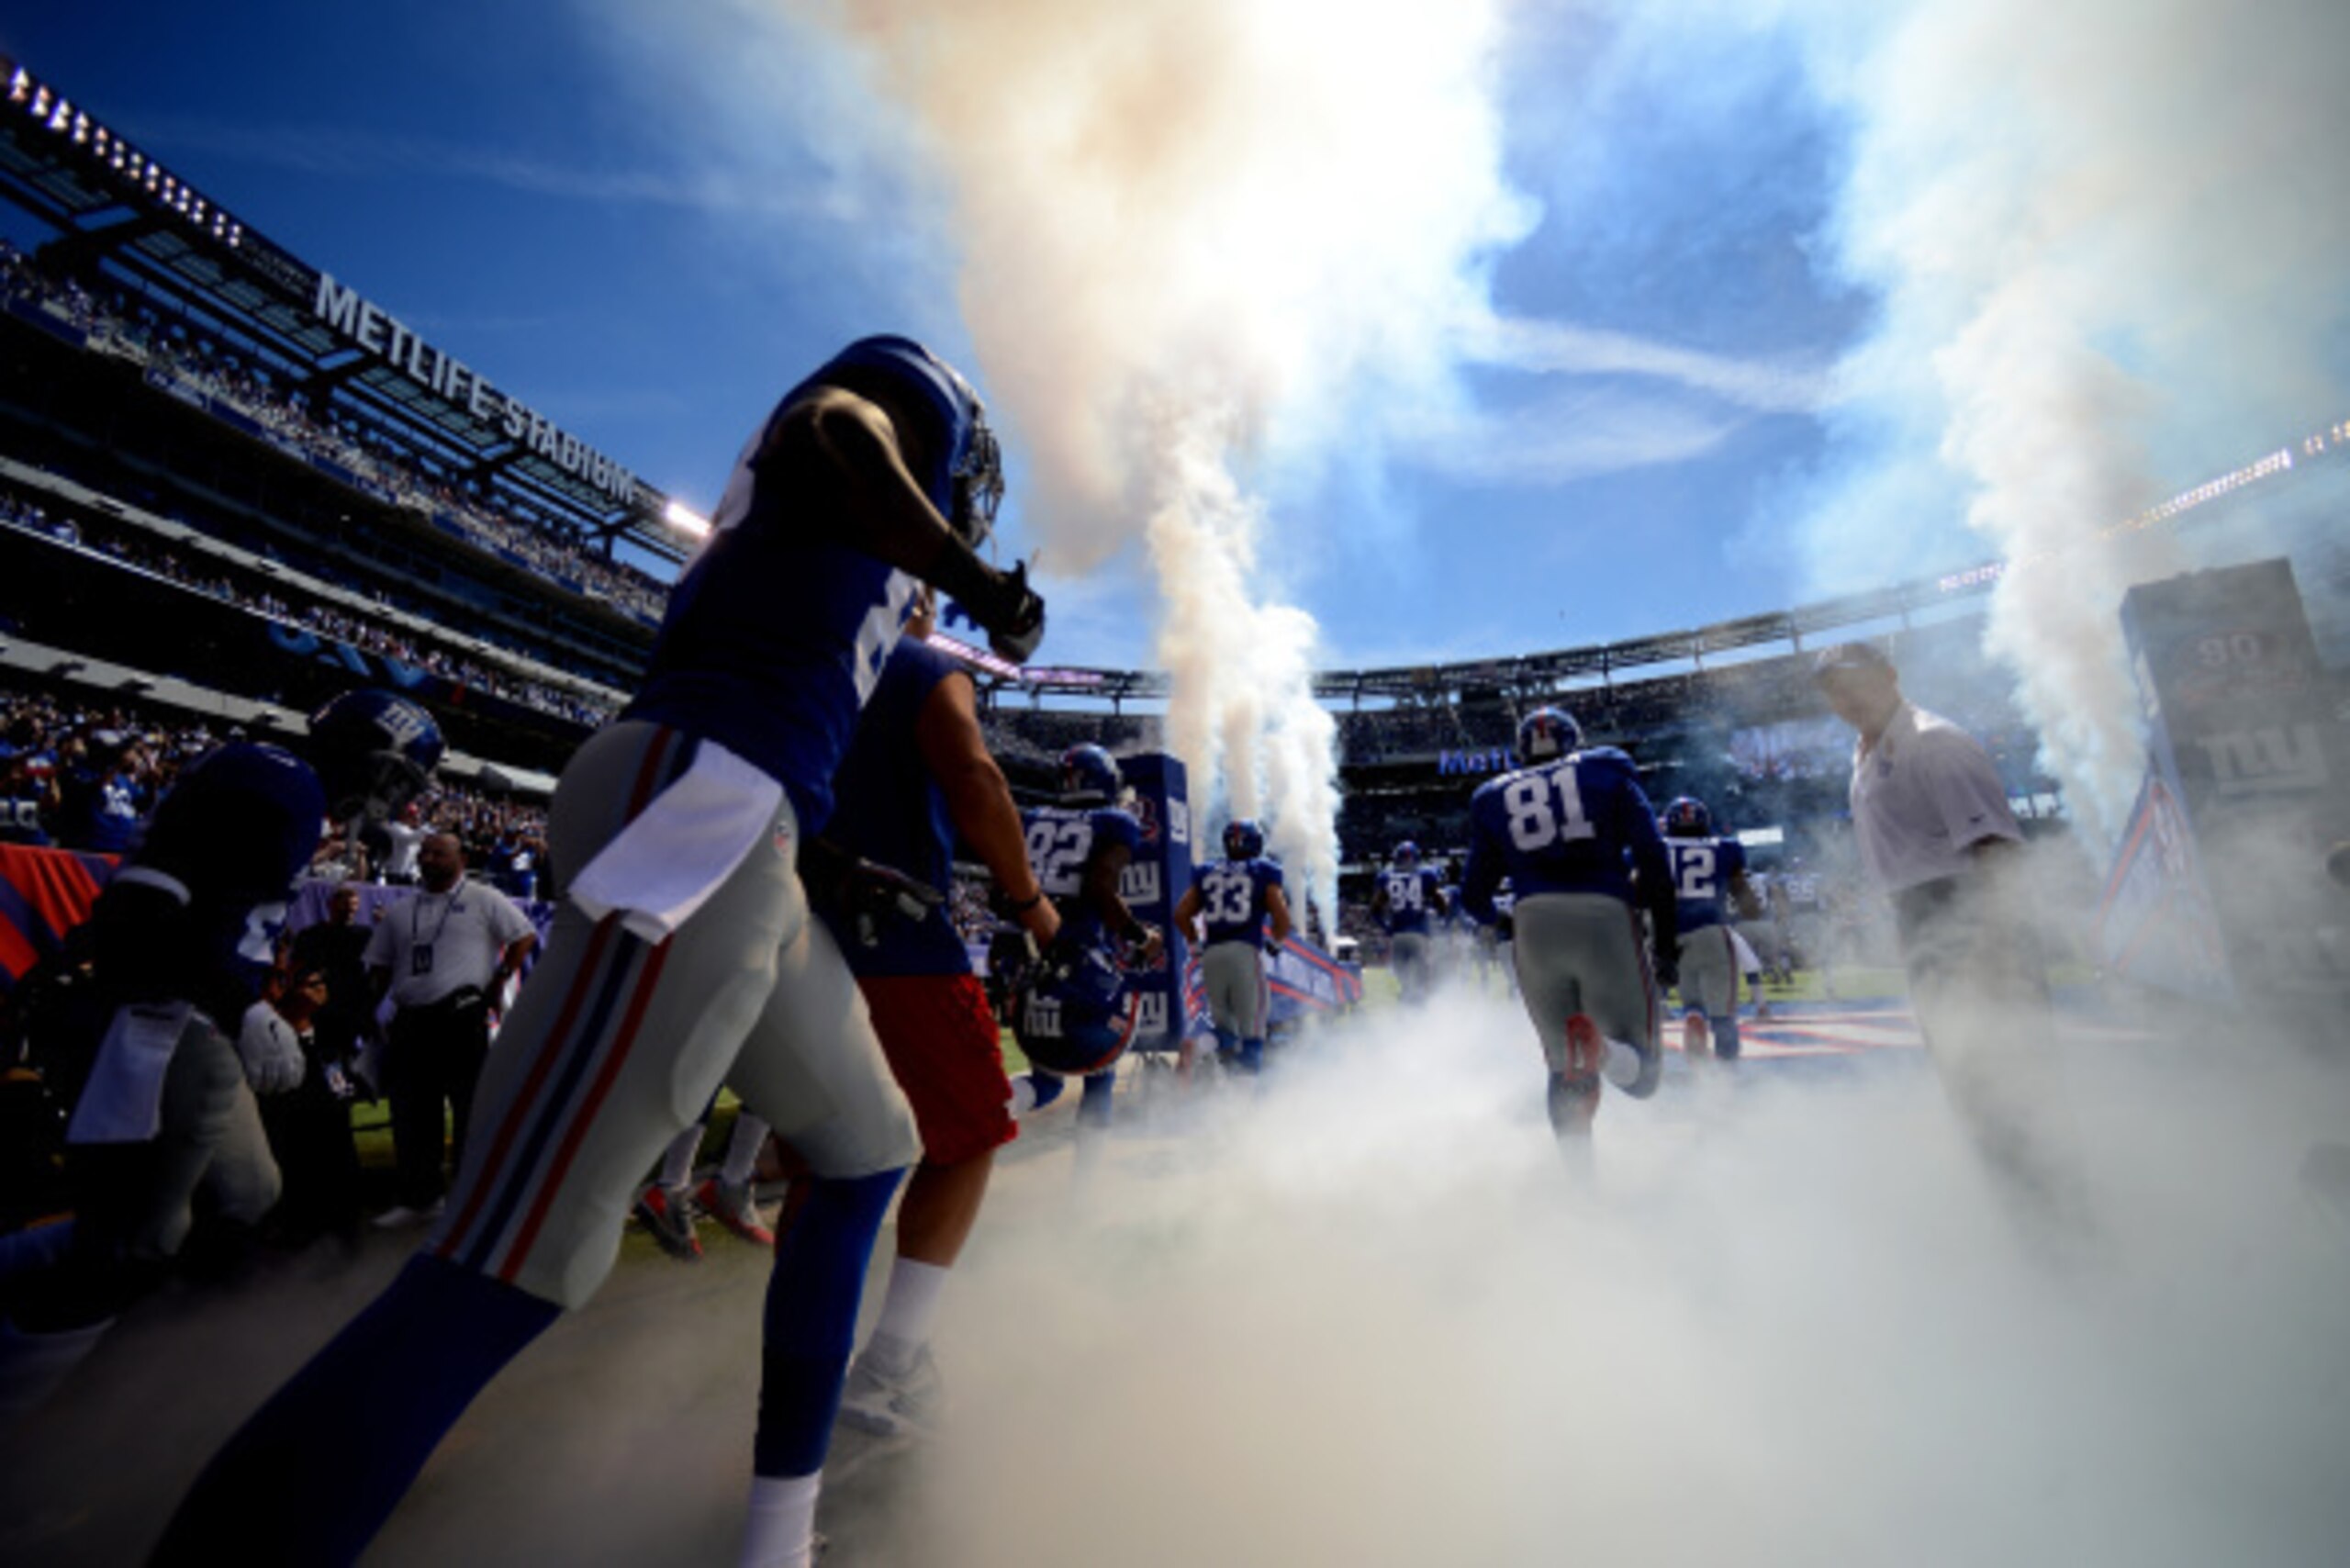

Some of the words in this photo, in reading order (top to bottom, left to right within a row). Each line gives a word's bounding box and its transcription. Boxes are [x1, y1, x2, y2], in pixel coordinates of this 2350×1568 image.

[315, 273, 497, 421] METLIFE
[503, 396, 635, 505] STADIUM
[1504, 766, 1595, 852] 81
[1202, 873, 1254, 923] 33
